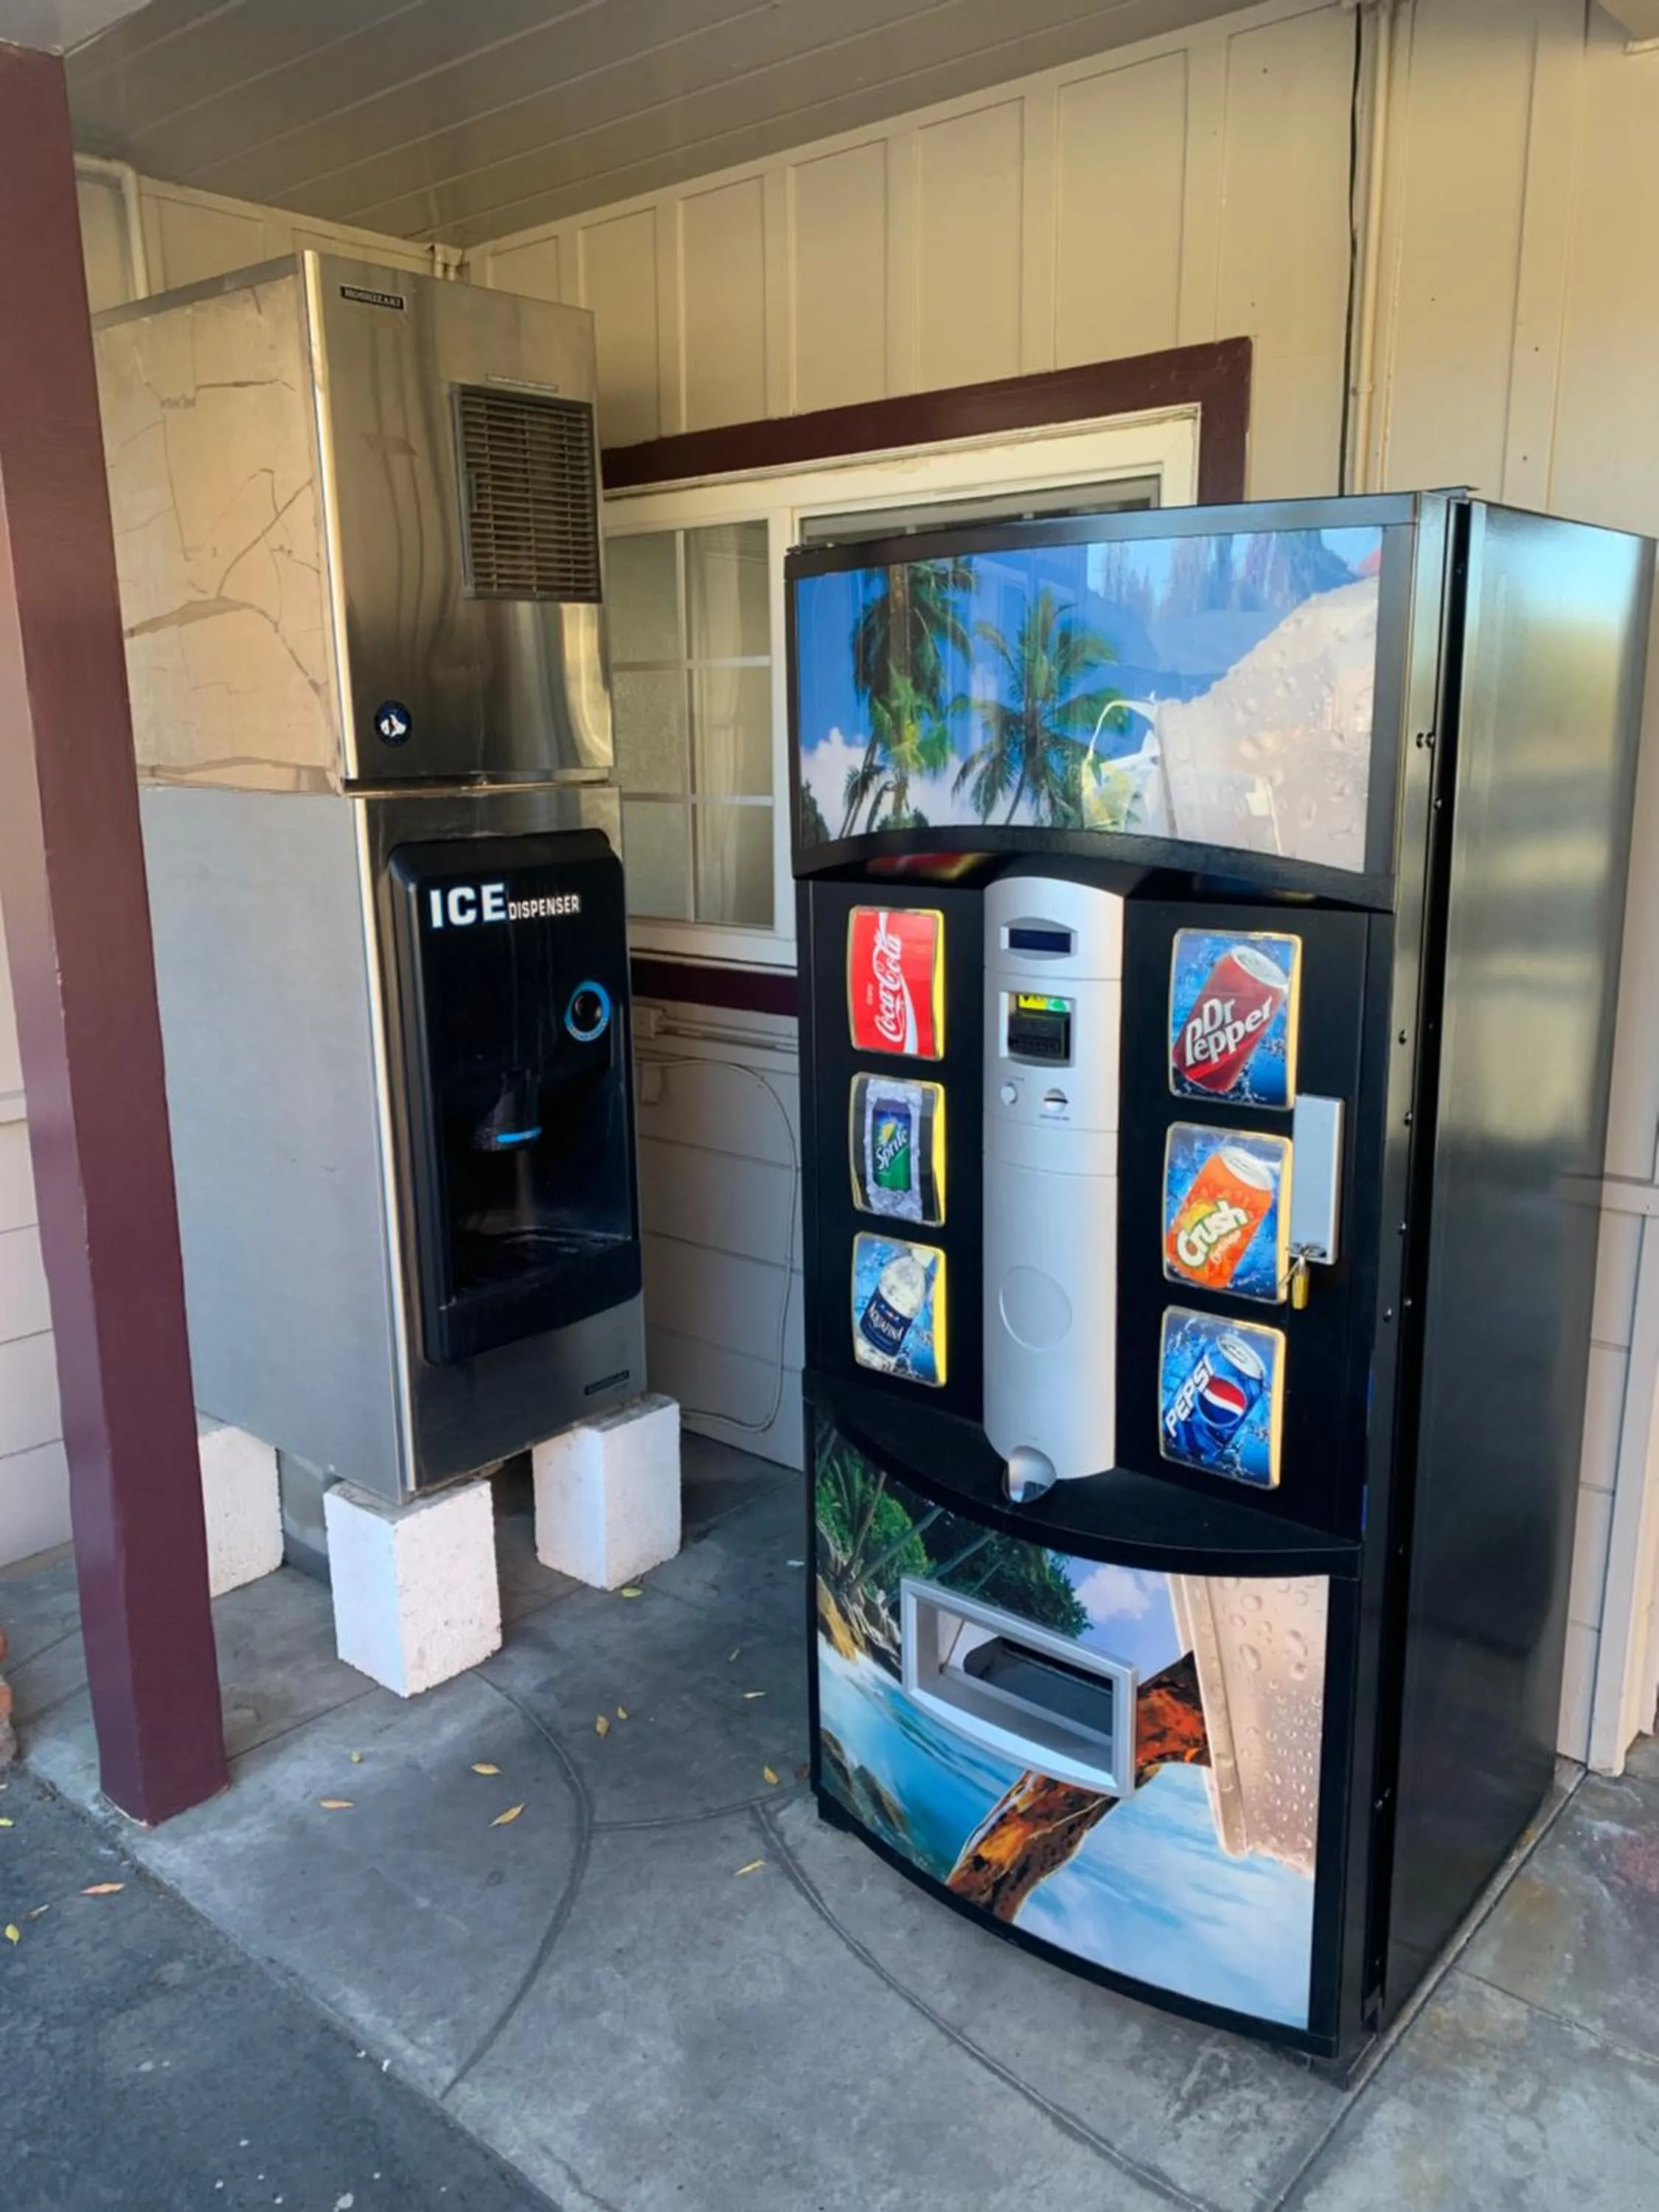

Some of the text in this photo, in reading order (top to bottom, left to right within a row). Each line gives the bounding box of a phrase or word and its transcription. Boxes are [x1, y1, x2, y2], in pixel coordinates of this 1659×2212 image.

[430, 883, 581, 928] ICE DISPENSER
[1184, 995, 1273, 1067] Pepper
[1202, 997, 1236, 1032] Dr
[1176, 1199, 1249, 1267] Crush
[1165, 1354, 1215, 1438] PEPSI
